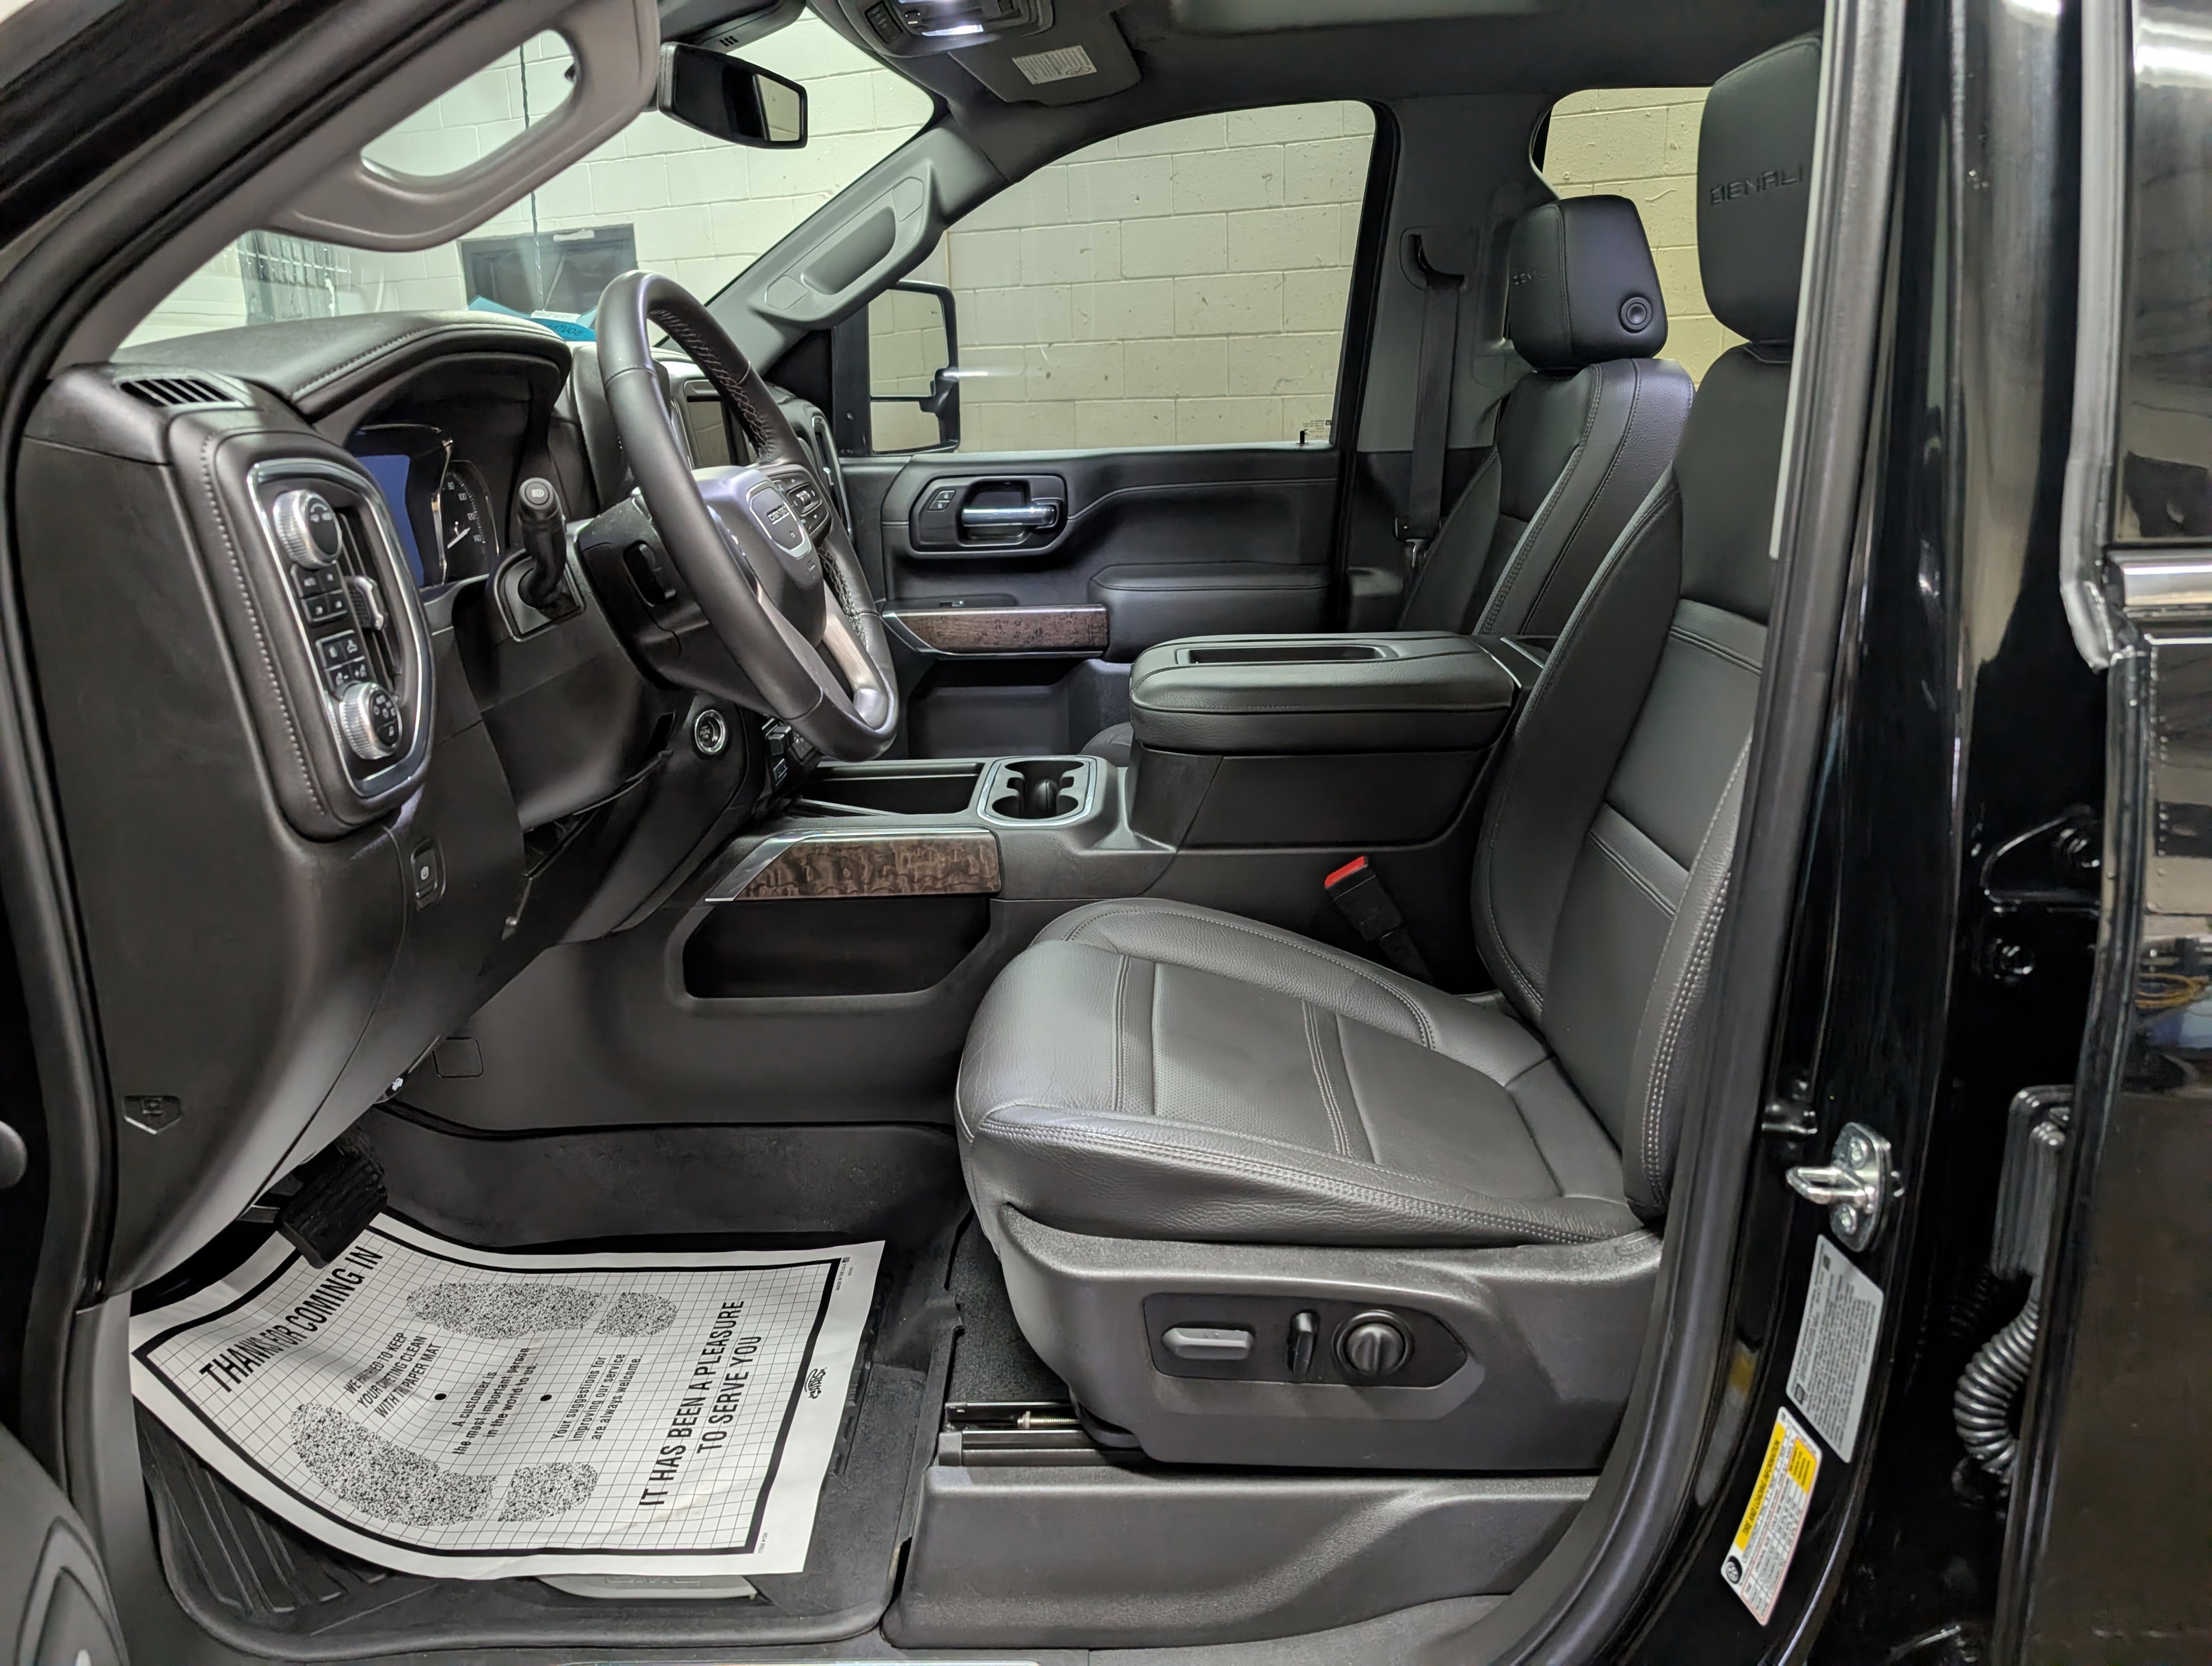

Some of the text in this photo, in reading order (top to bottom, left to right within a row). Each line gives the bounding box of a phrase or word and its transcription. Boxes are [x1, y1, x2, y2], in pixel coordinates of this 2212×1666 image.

[1710, 165, 1803, 206] DENALI
[199, 1337, 284, 1393] THANKS
[285, 1268, 365, 1332] COMING
[344, 1246, 383, 1270] IN
[343, 1379, 362, 1394] WE
[377, 1351, 393, 1362] TO
[385, 1332, 407, 1352] KEEP
[357, 1381, 383, 1408] YOUR
[400, 1336, 427, 1362] CLEAN
[374, 1394, 400, 1418] WITH
[402, 1363, 429, 1389] PAPER
[421, 1343, 441, 1362] MAT
[452, 1348, 530, 1454] the most important person
[459, 1380, 490, 1418] customer
[490, 1413, 508, 1426] the
[502, 1388, 524, 1411] world
[515, 1377, 529, 1386] to
[524, 1363, 538, 1375] us.
[550, 1357, 606, 1440] Your suggestions for
[568, 1354, 626, 1441] improving our service
[591, 1355, 643, 1439] are always welcome.
[639, 1301, 744, 1505] IT HAS BEEN A PLEASURE
[696, 1336, 762, 1454] TO SERVE YOU
[1741, 1520, 1752, 1536] TIRE
[1748, 1507, 1757, 1522] AND
[1753, 1479, 1767, 1510] LOADING
[1763, 1439, 1780, 1482] INFORMATION
